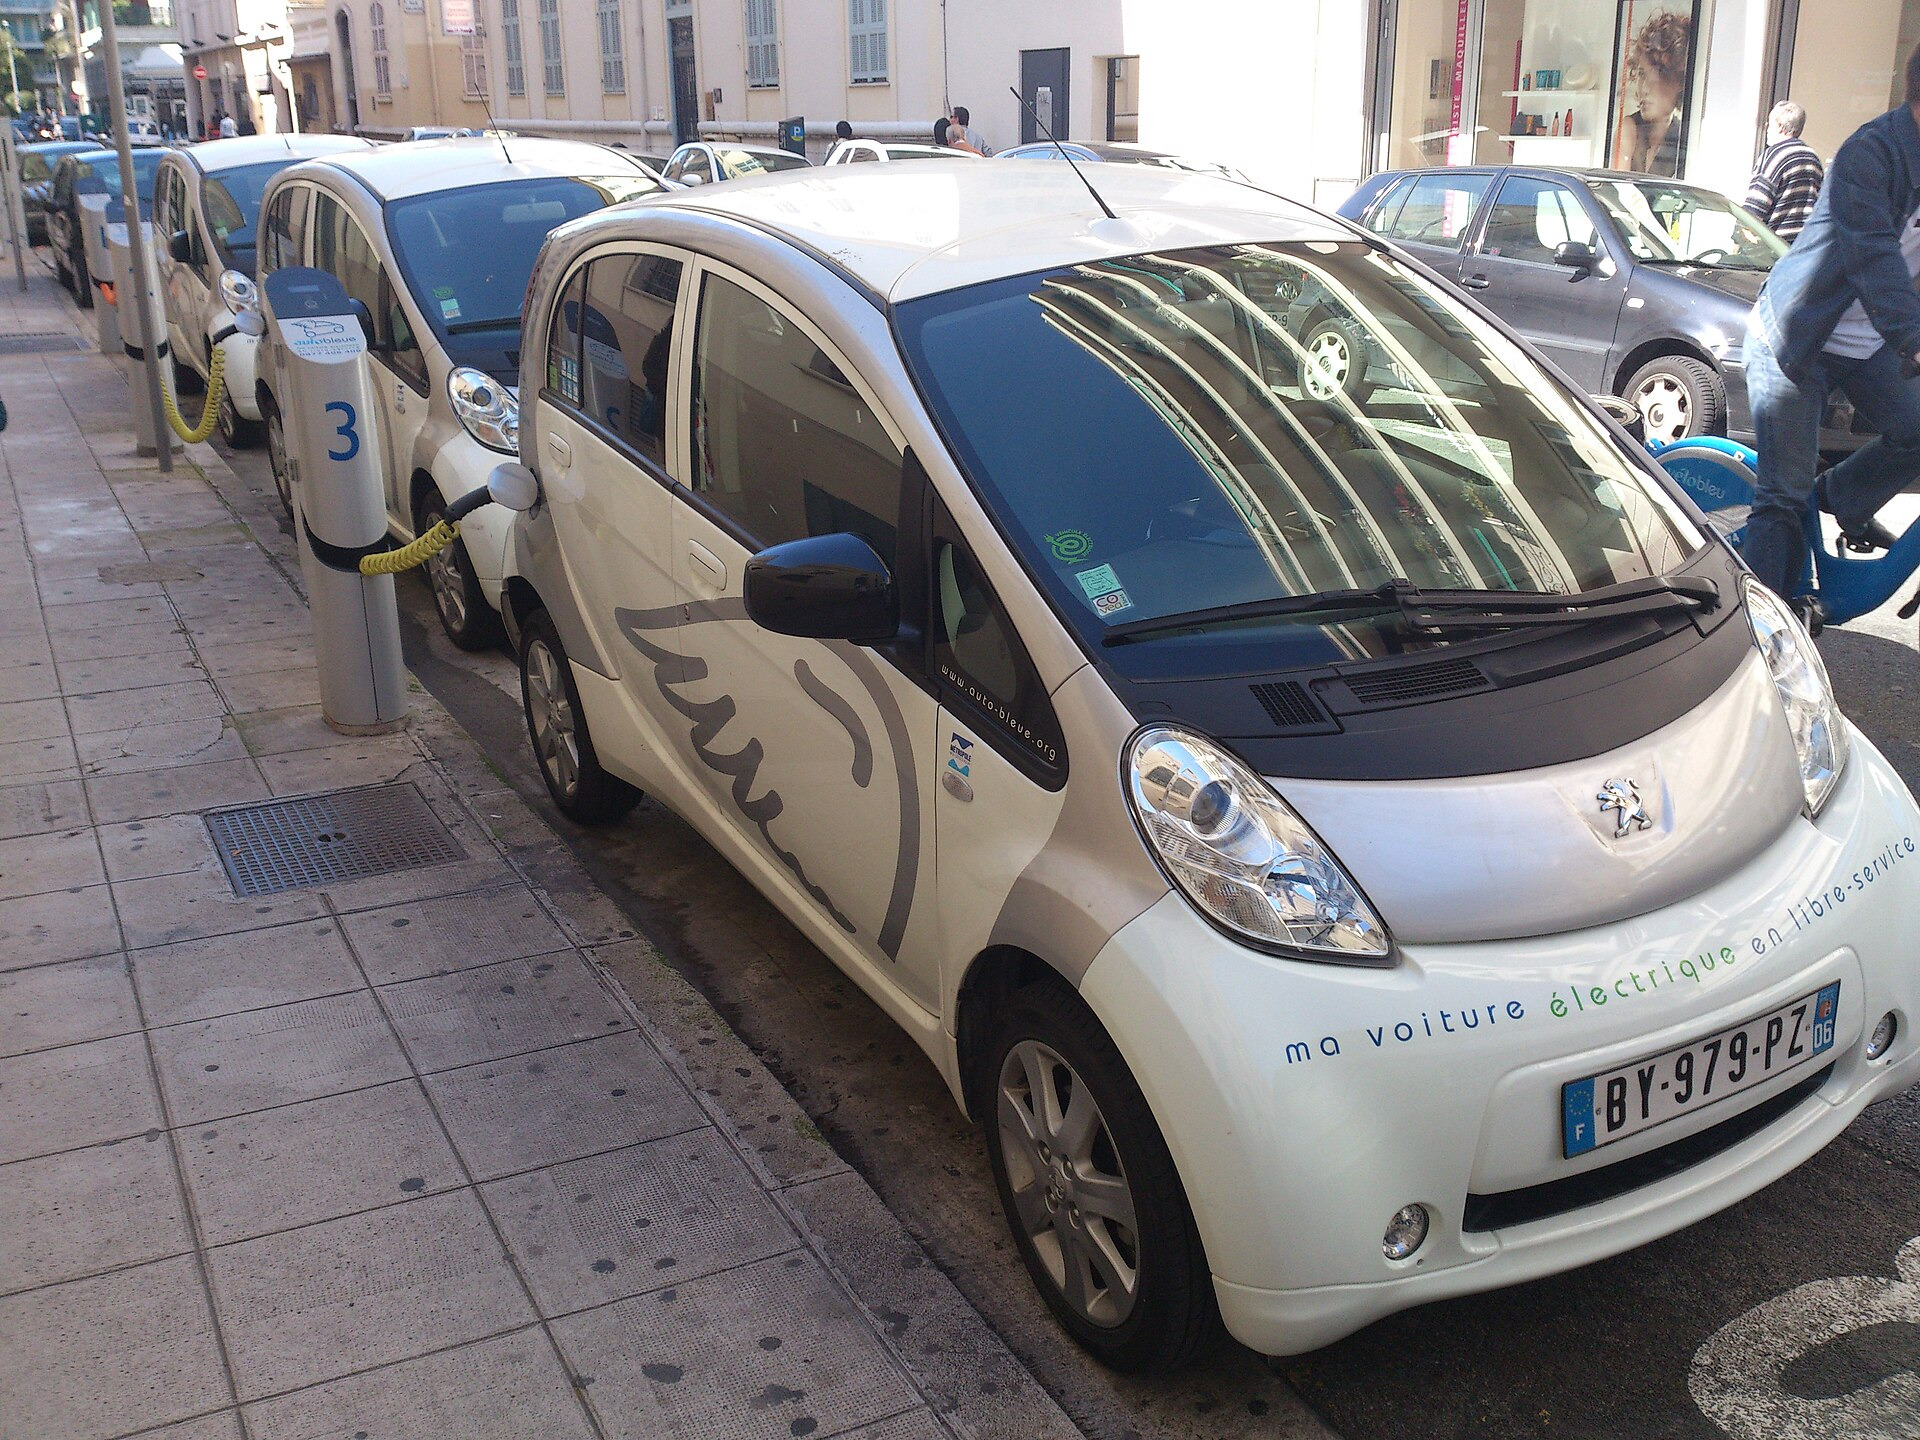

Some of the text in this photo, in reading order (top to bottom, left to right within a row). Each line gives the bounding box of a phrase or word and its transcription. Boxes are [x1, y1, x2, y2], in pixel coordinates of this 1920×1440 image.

[793, 126, 801, 137] P
[325, 401, 360, 461] 3
[941, 664, 1056, 761] www.auto-bleue.org
[1285, 836, 1916, 1064] ma voiture électrique en libre-service
[1574, 1003, 1833, 1141] F BY-979-PZ 06
